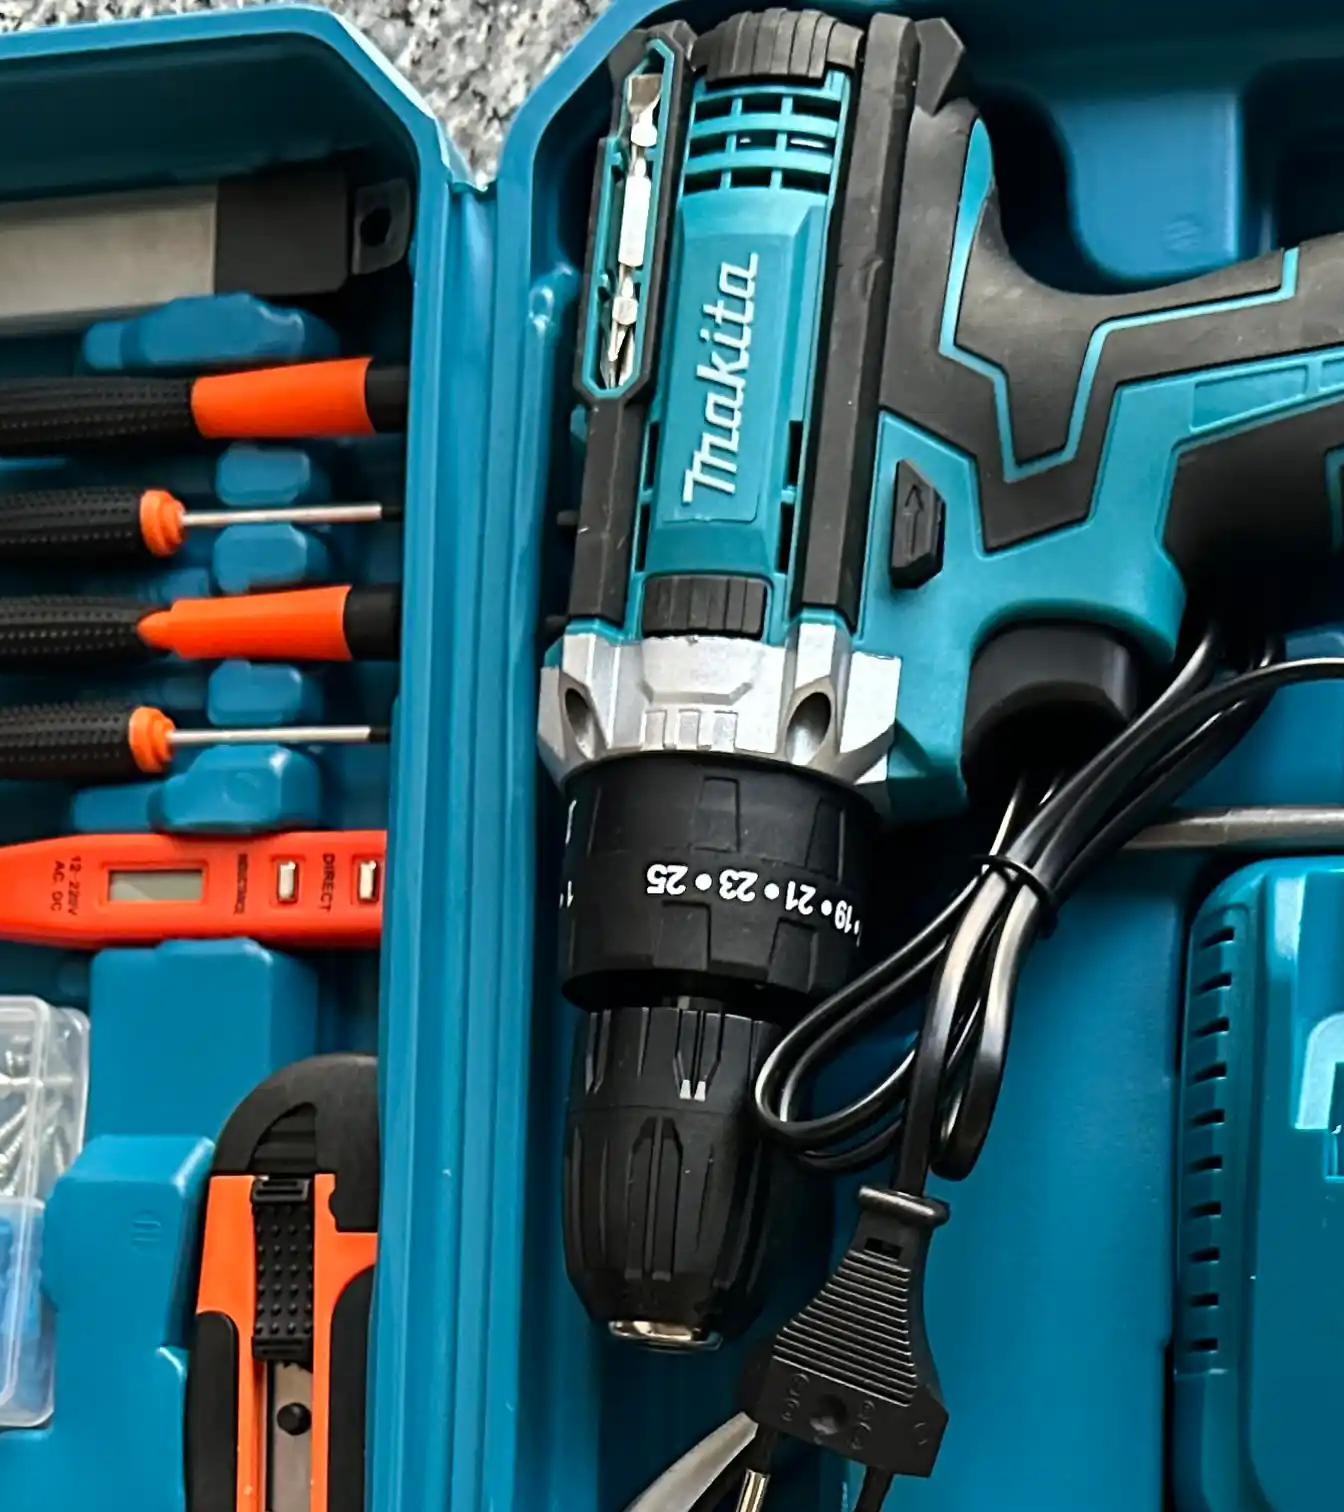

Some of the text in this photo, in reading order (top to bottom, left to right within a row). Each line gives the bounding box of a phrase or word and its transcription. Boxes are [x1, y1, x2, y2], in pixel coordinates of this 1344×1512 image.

[682, 252, 759, 503] Makita
[318, 853, 335, 912] DIRECT
[646, 864, 688, 896] 25
[719, 869, 758, 902] 23
[785, 881, 817, 915] 21
